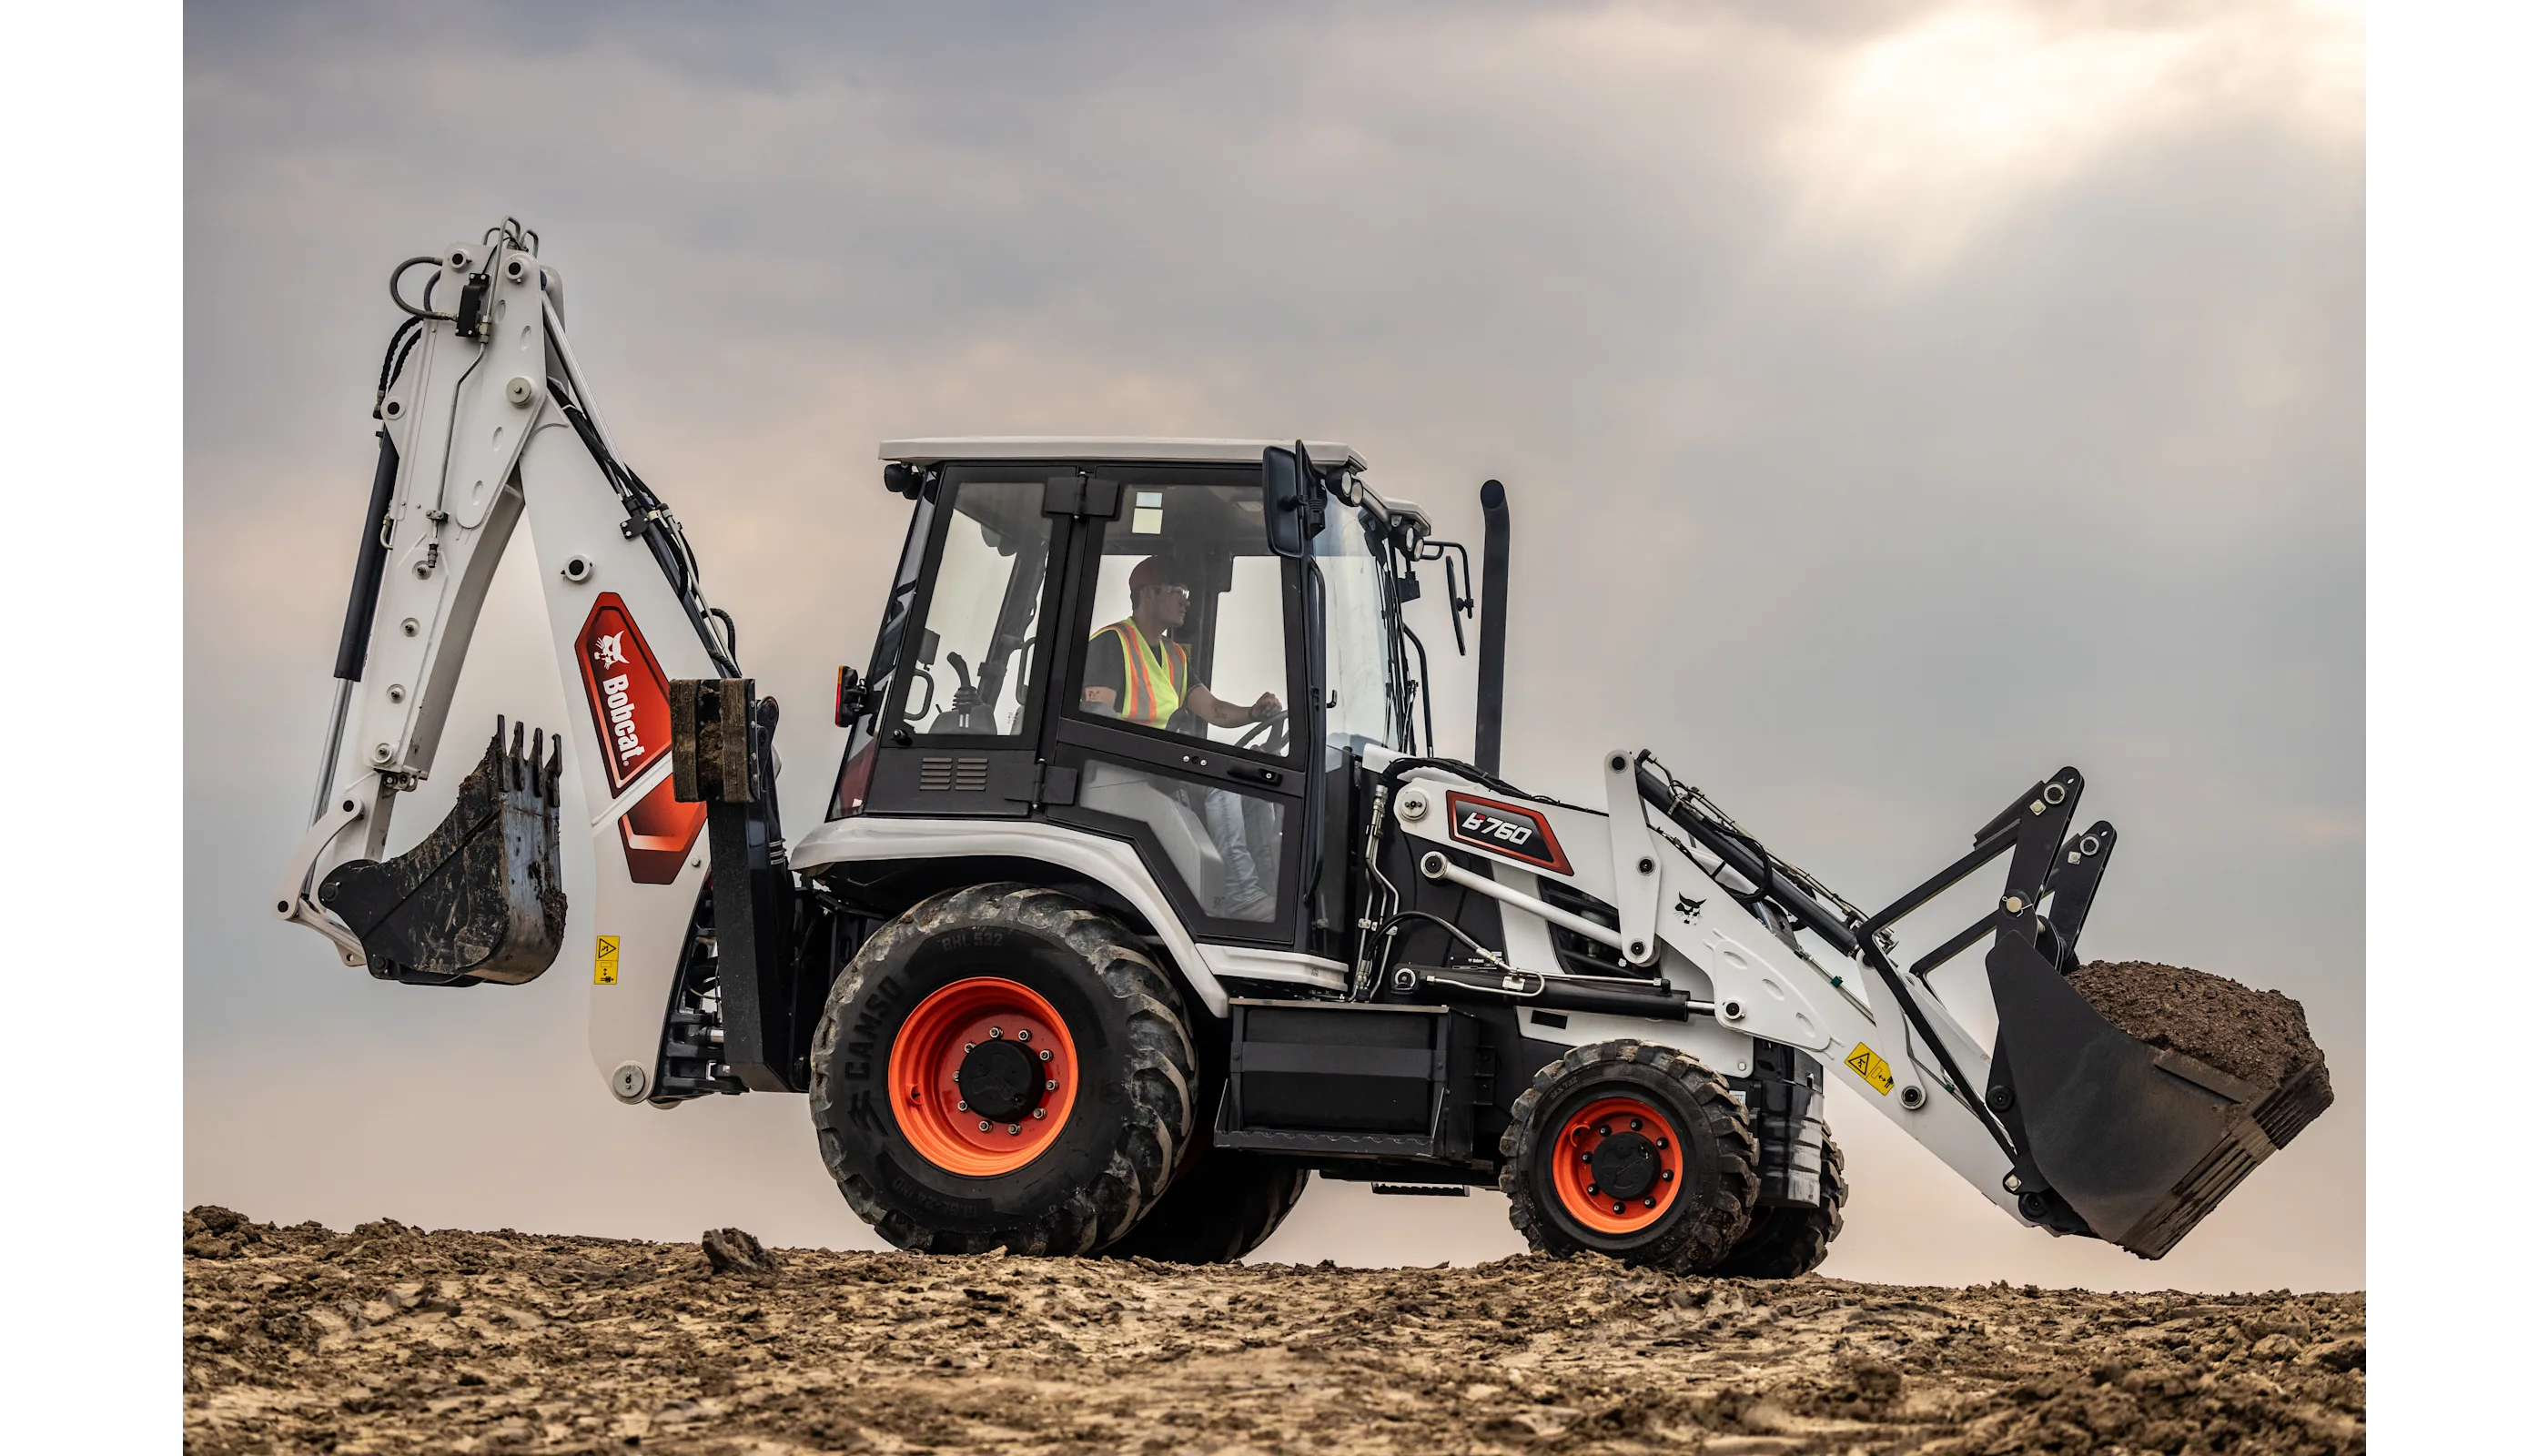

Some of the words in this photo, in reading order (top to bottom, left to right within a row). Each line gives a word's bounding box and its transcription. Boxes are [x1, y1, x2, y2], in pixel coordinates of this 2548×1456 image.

[602, 673, 645, 762] Bobcat
[942, 934, 971, 952] BHL
[974, 932, 1004, 947] 532
[844, 976, 905, 1081] CAMSO
